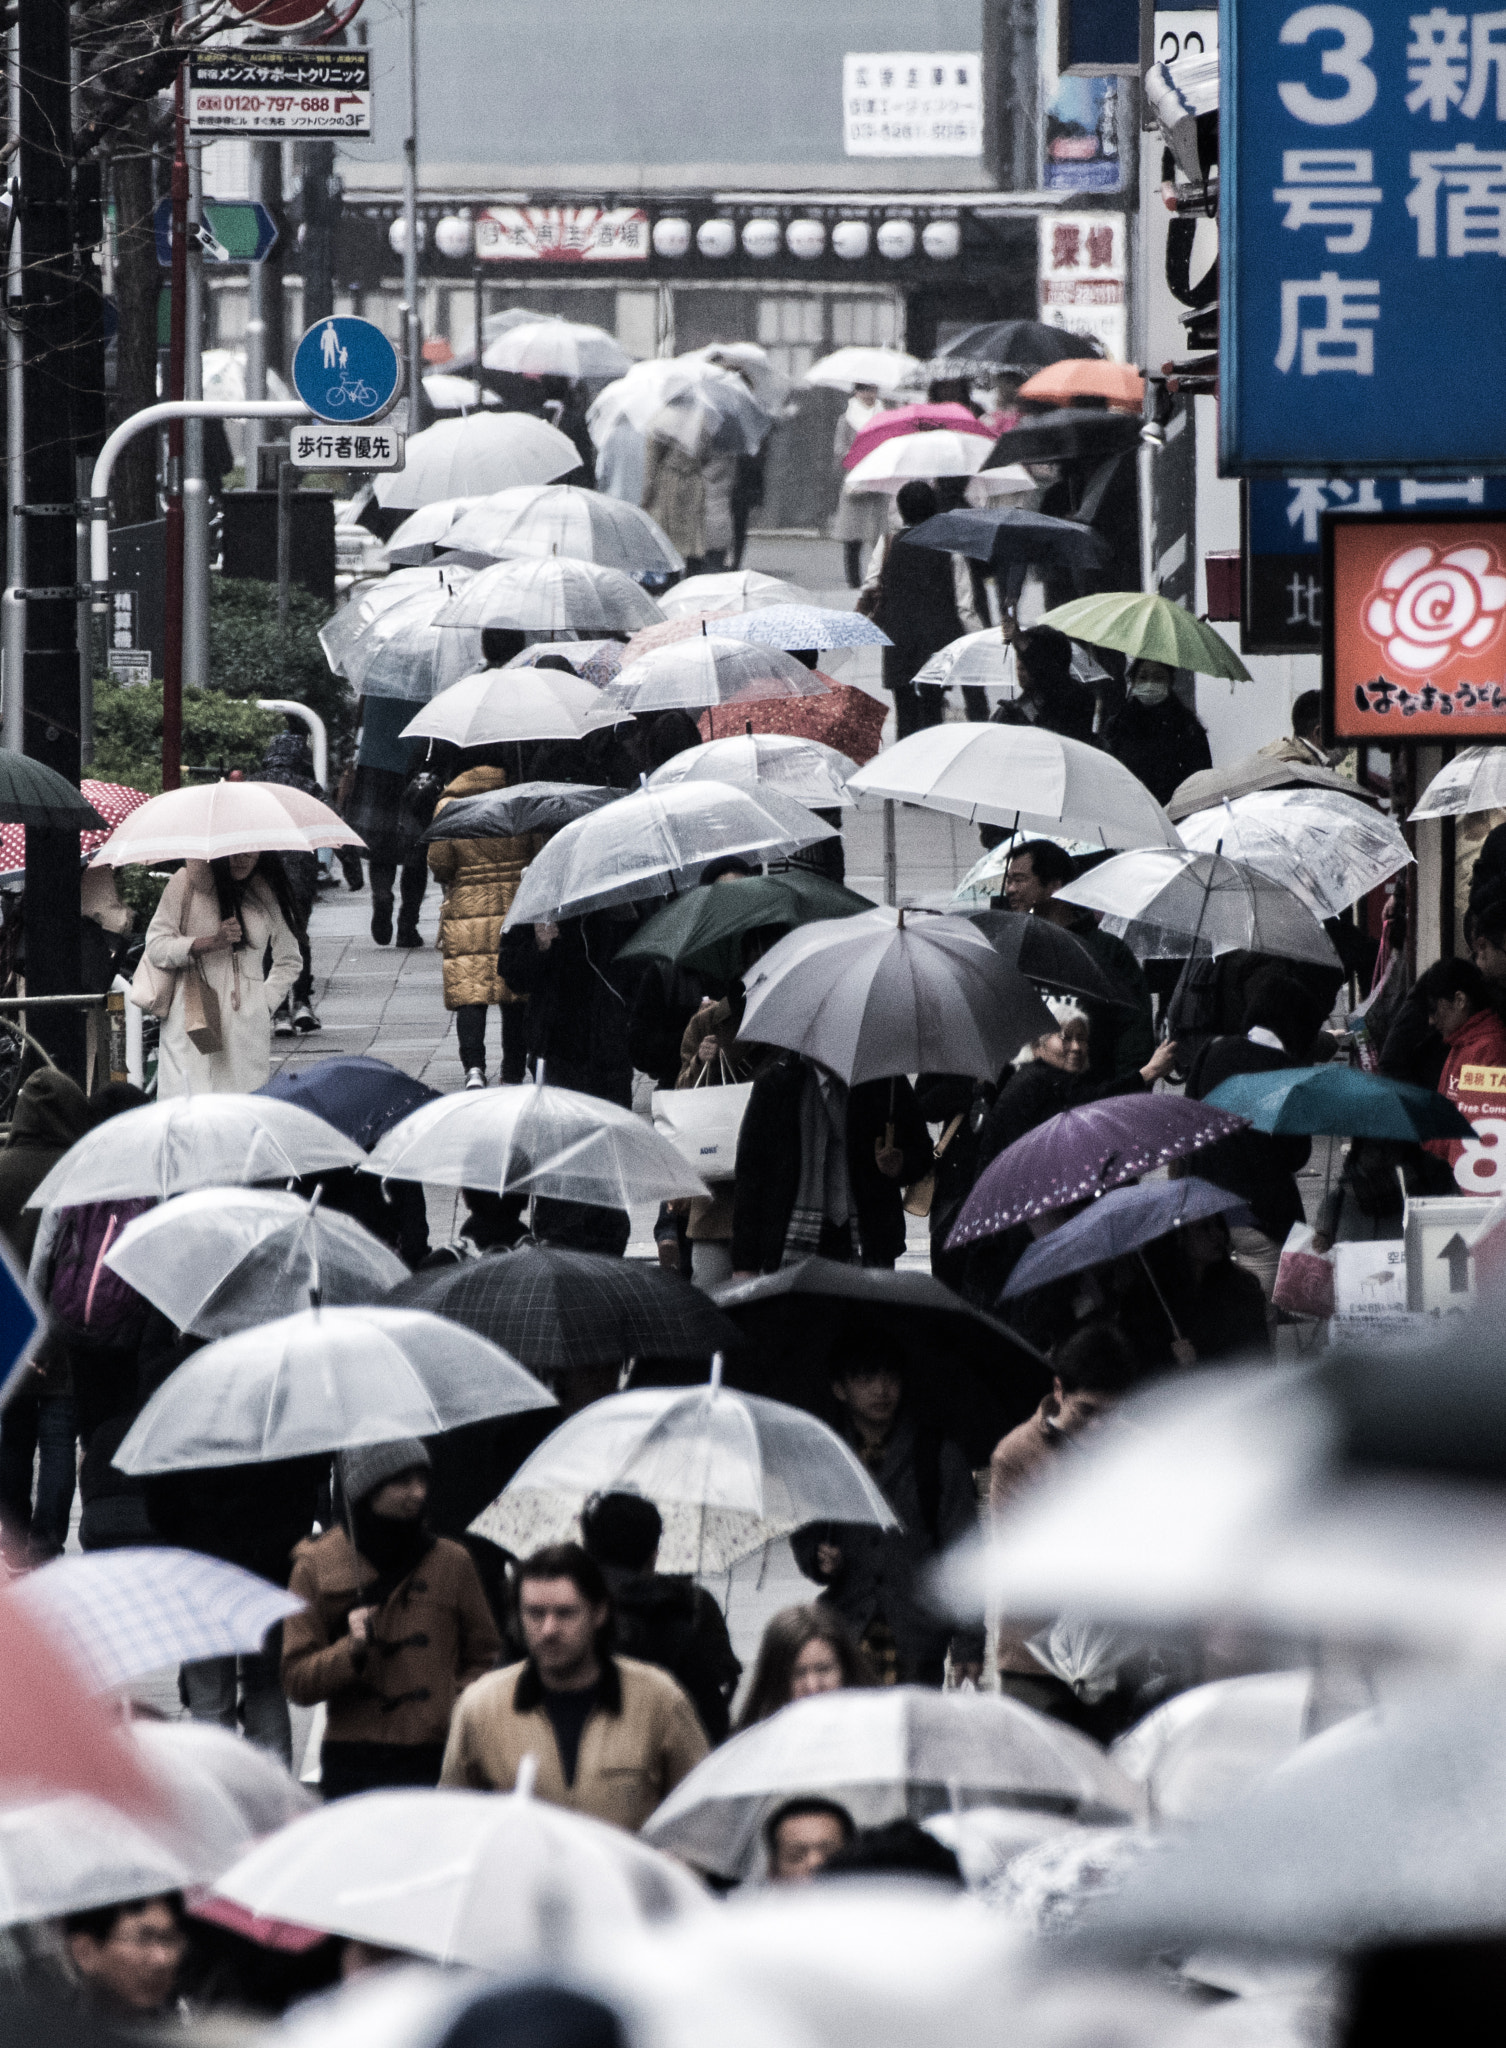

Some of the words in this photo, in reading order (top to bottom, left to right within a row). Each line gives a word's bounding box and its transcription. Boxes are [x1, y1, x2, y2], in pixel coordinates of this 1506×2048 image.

[224, 95, 330, 112] 0120-797-688
[1405, 8, 1506, 258] 新宿
[1273, 4, 1383, 376] 3号店
[297, 436, 390, 459] 歩行者優先
[1355, 675, 1506, 716] はなまるうどん
[1458, 1102, 1480, 1114] Free
